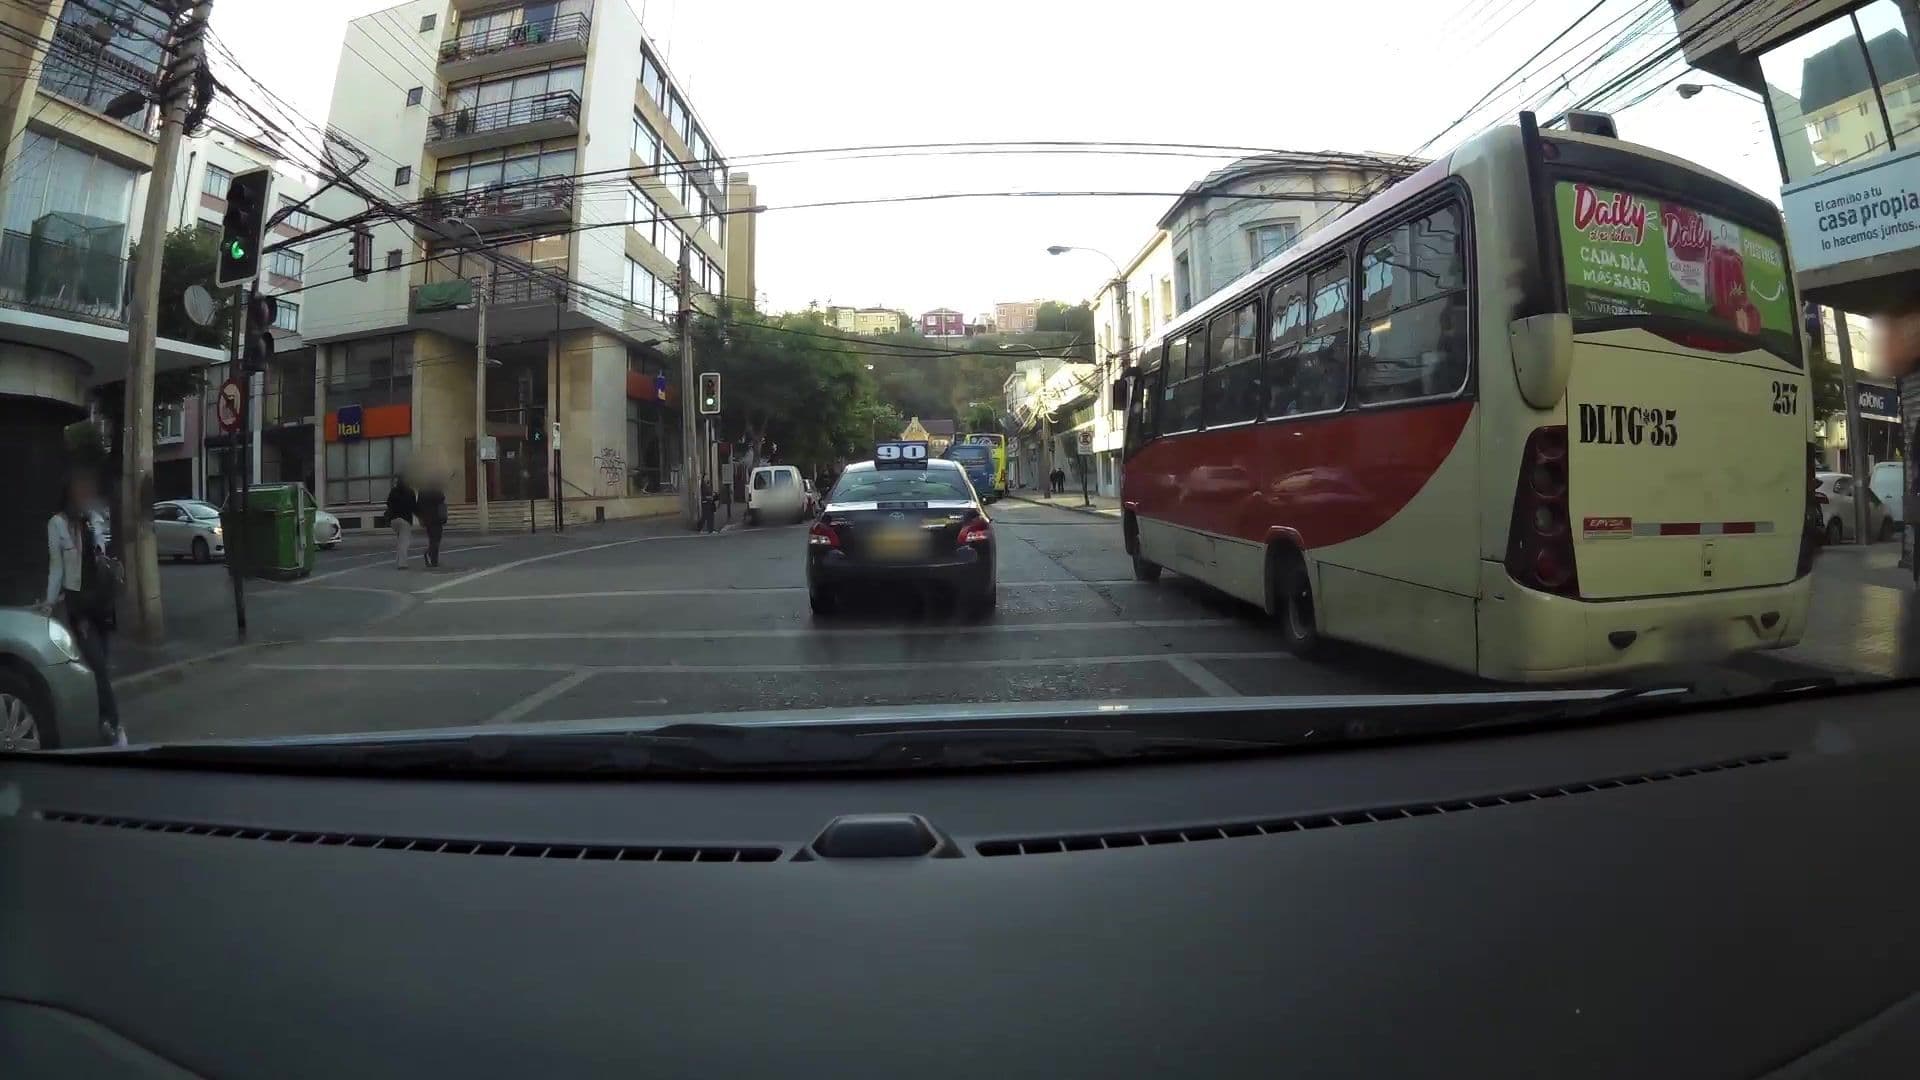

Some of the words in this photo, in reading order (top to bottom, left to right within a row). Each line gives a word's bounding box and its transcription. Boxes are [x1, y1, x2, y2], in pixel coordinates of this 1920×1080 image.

[1815, 200, 1824, 212] El
[1825, 192, 1862, 210] camino
[1863, 190, 1870, 199] a
[1871, 186, 1882, 197] tu
[1819, 209, 1858, 232] casa
[1861, 189, 1920, 226] propia
[1573, 184, 1646, 246] Daily
[1665, 212, 1713, 264] Daily
[1822, 239, 1831, 250] lo
[1833, 228, 1879, 248] hacemos
[1580, 246, 1619, 268] CADA
[1772, 381, 1798, 416] 257
[877, 445, 926, 460] 90
